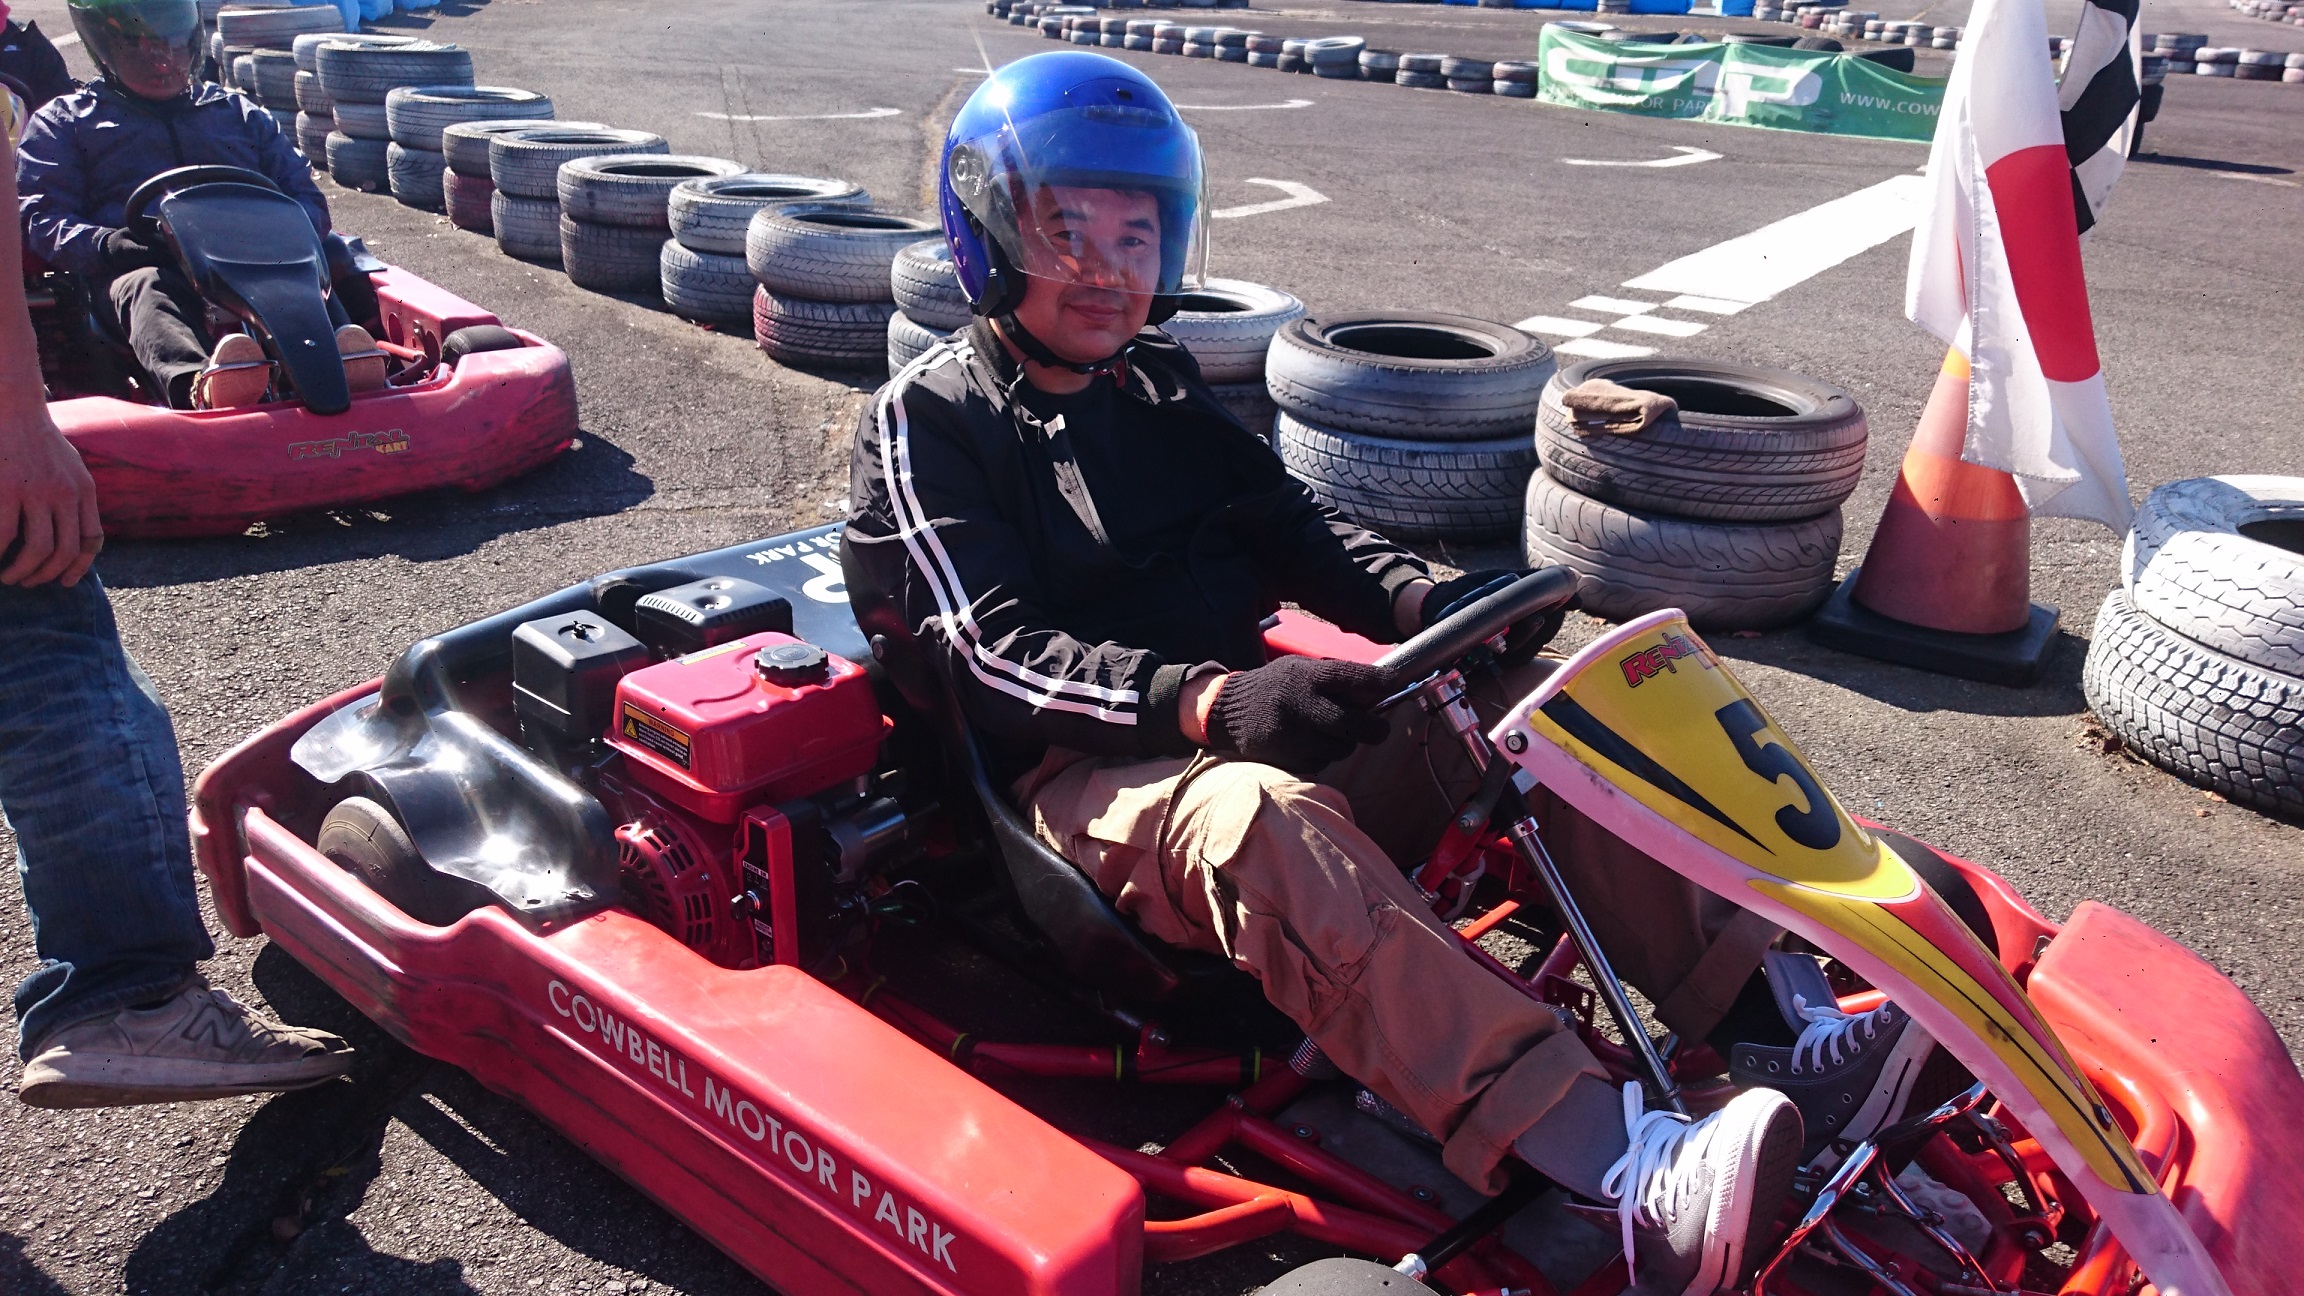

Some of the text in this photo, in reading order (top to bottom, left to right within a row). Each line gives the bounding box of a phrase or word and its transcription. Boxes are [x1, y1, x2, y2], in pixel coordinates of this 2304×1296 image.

[746, 541, 814, 566] PARK
[1714, 697, 1841, 850] 5
[548, 979, 957, 1274] COWBELL MOTOR PARK
